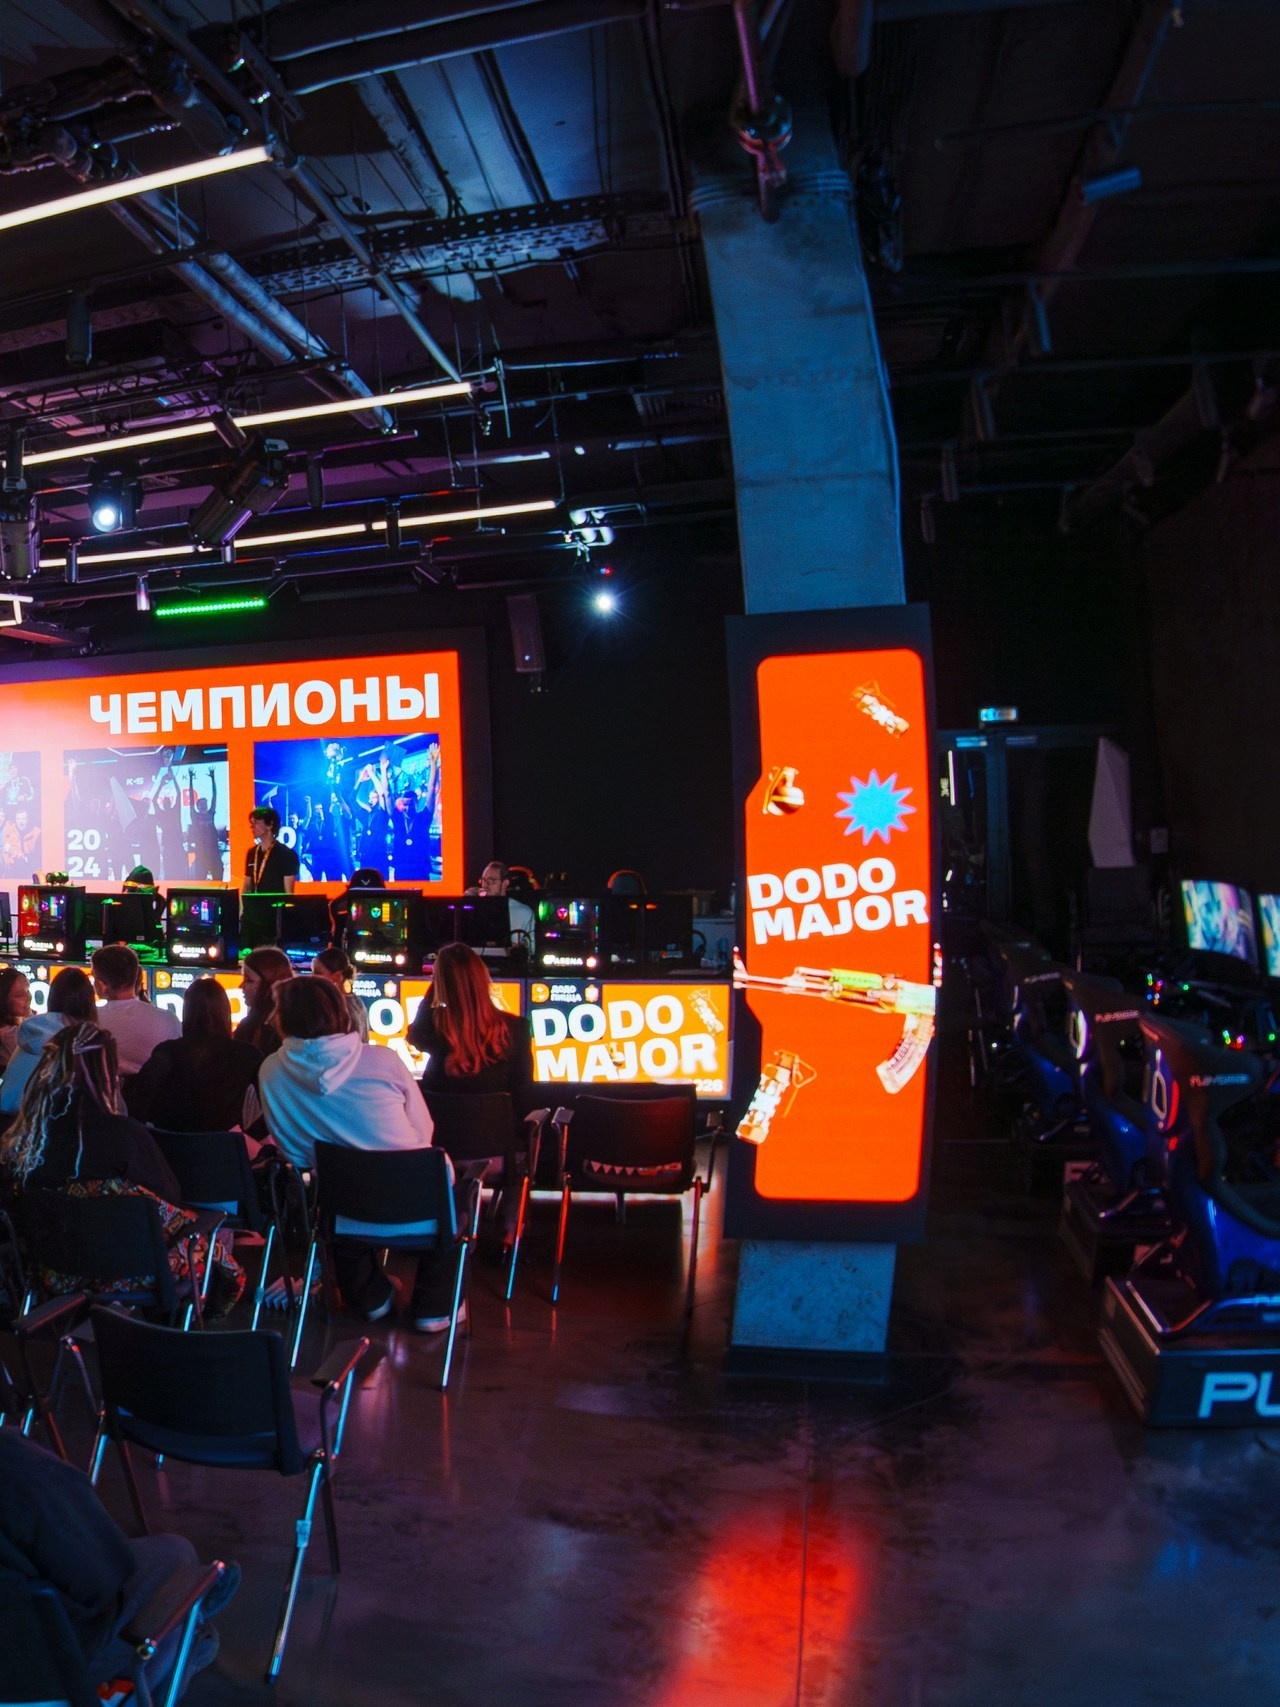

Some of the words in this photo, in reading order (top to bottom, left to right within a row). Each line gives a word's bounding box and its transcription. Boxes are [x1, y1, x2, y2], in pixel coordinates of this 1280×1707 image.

[90, 673, 440, 735] ЧЕМПИОНЫ
[67, 829, 101, 850] 20
[67, 856, 101, 878] 24
[747, 857, 896, 909] DODO
[752, 889, 930, 945] MAJOR
[550, 985, 577, 994] ДОДО
[550, 993, 582, 1003] ПИЦЦА
[531, 995, 684, 1047] DODO
[536, 1033, 718, 1082] MAJOR
